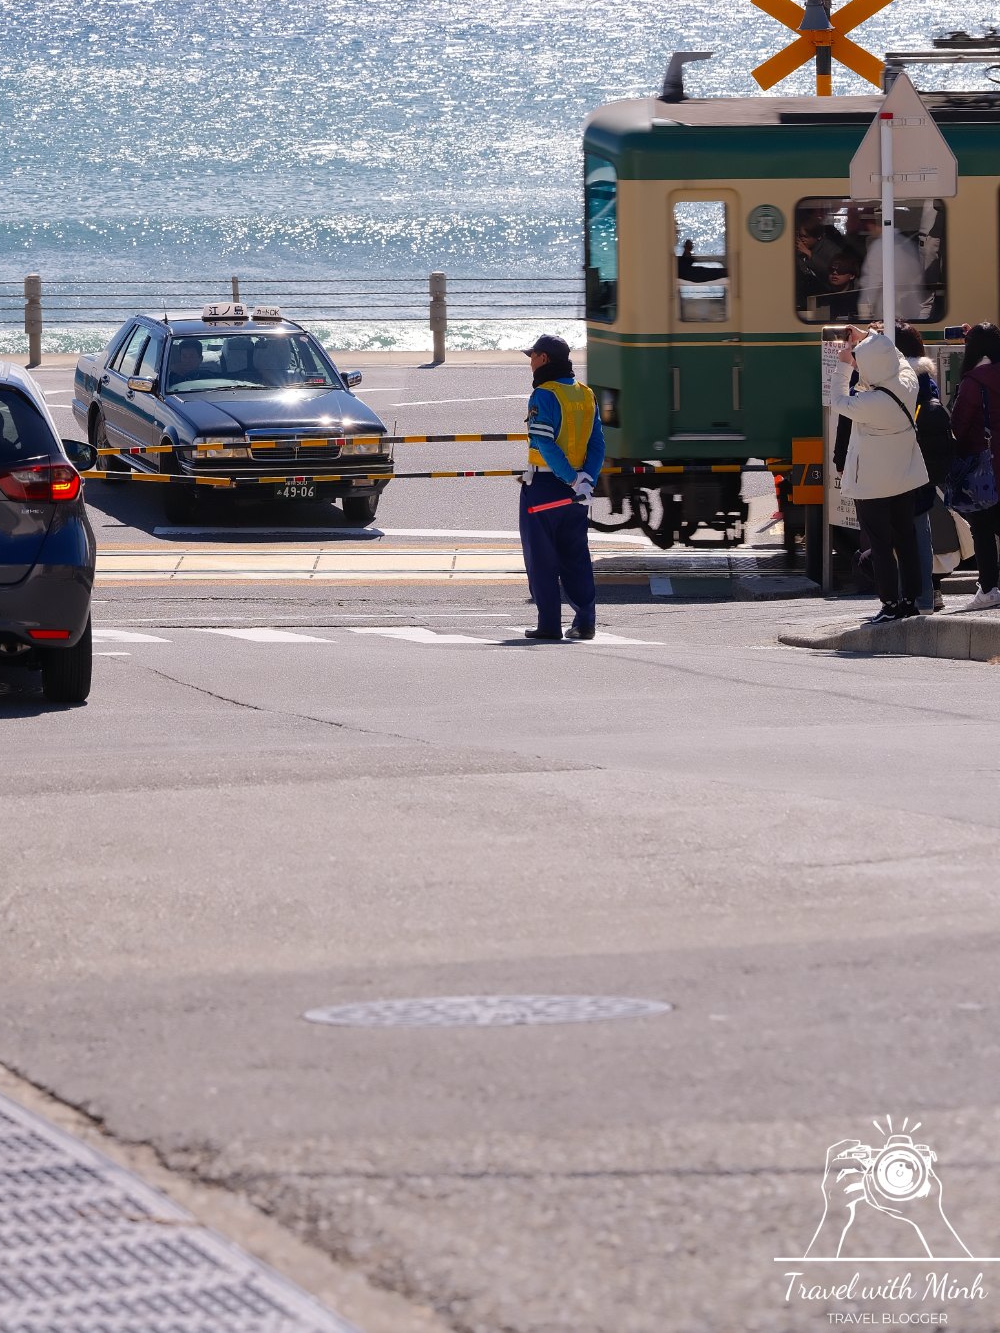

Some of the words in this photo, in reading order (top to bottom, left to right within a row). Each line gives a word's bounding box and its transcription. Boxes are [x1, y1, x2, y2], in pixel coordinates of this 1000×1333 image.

[208, 306, 244, 316] 江ノ島
[283, 486, 314, 497] 49-06
